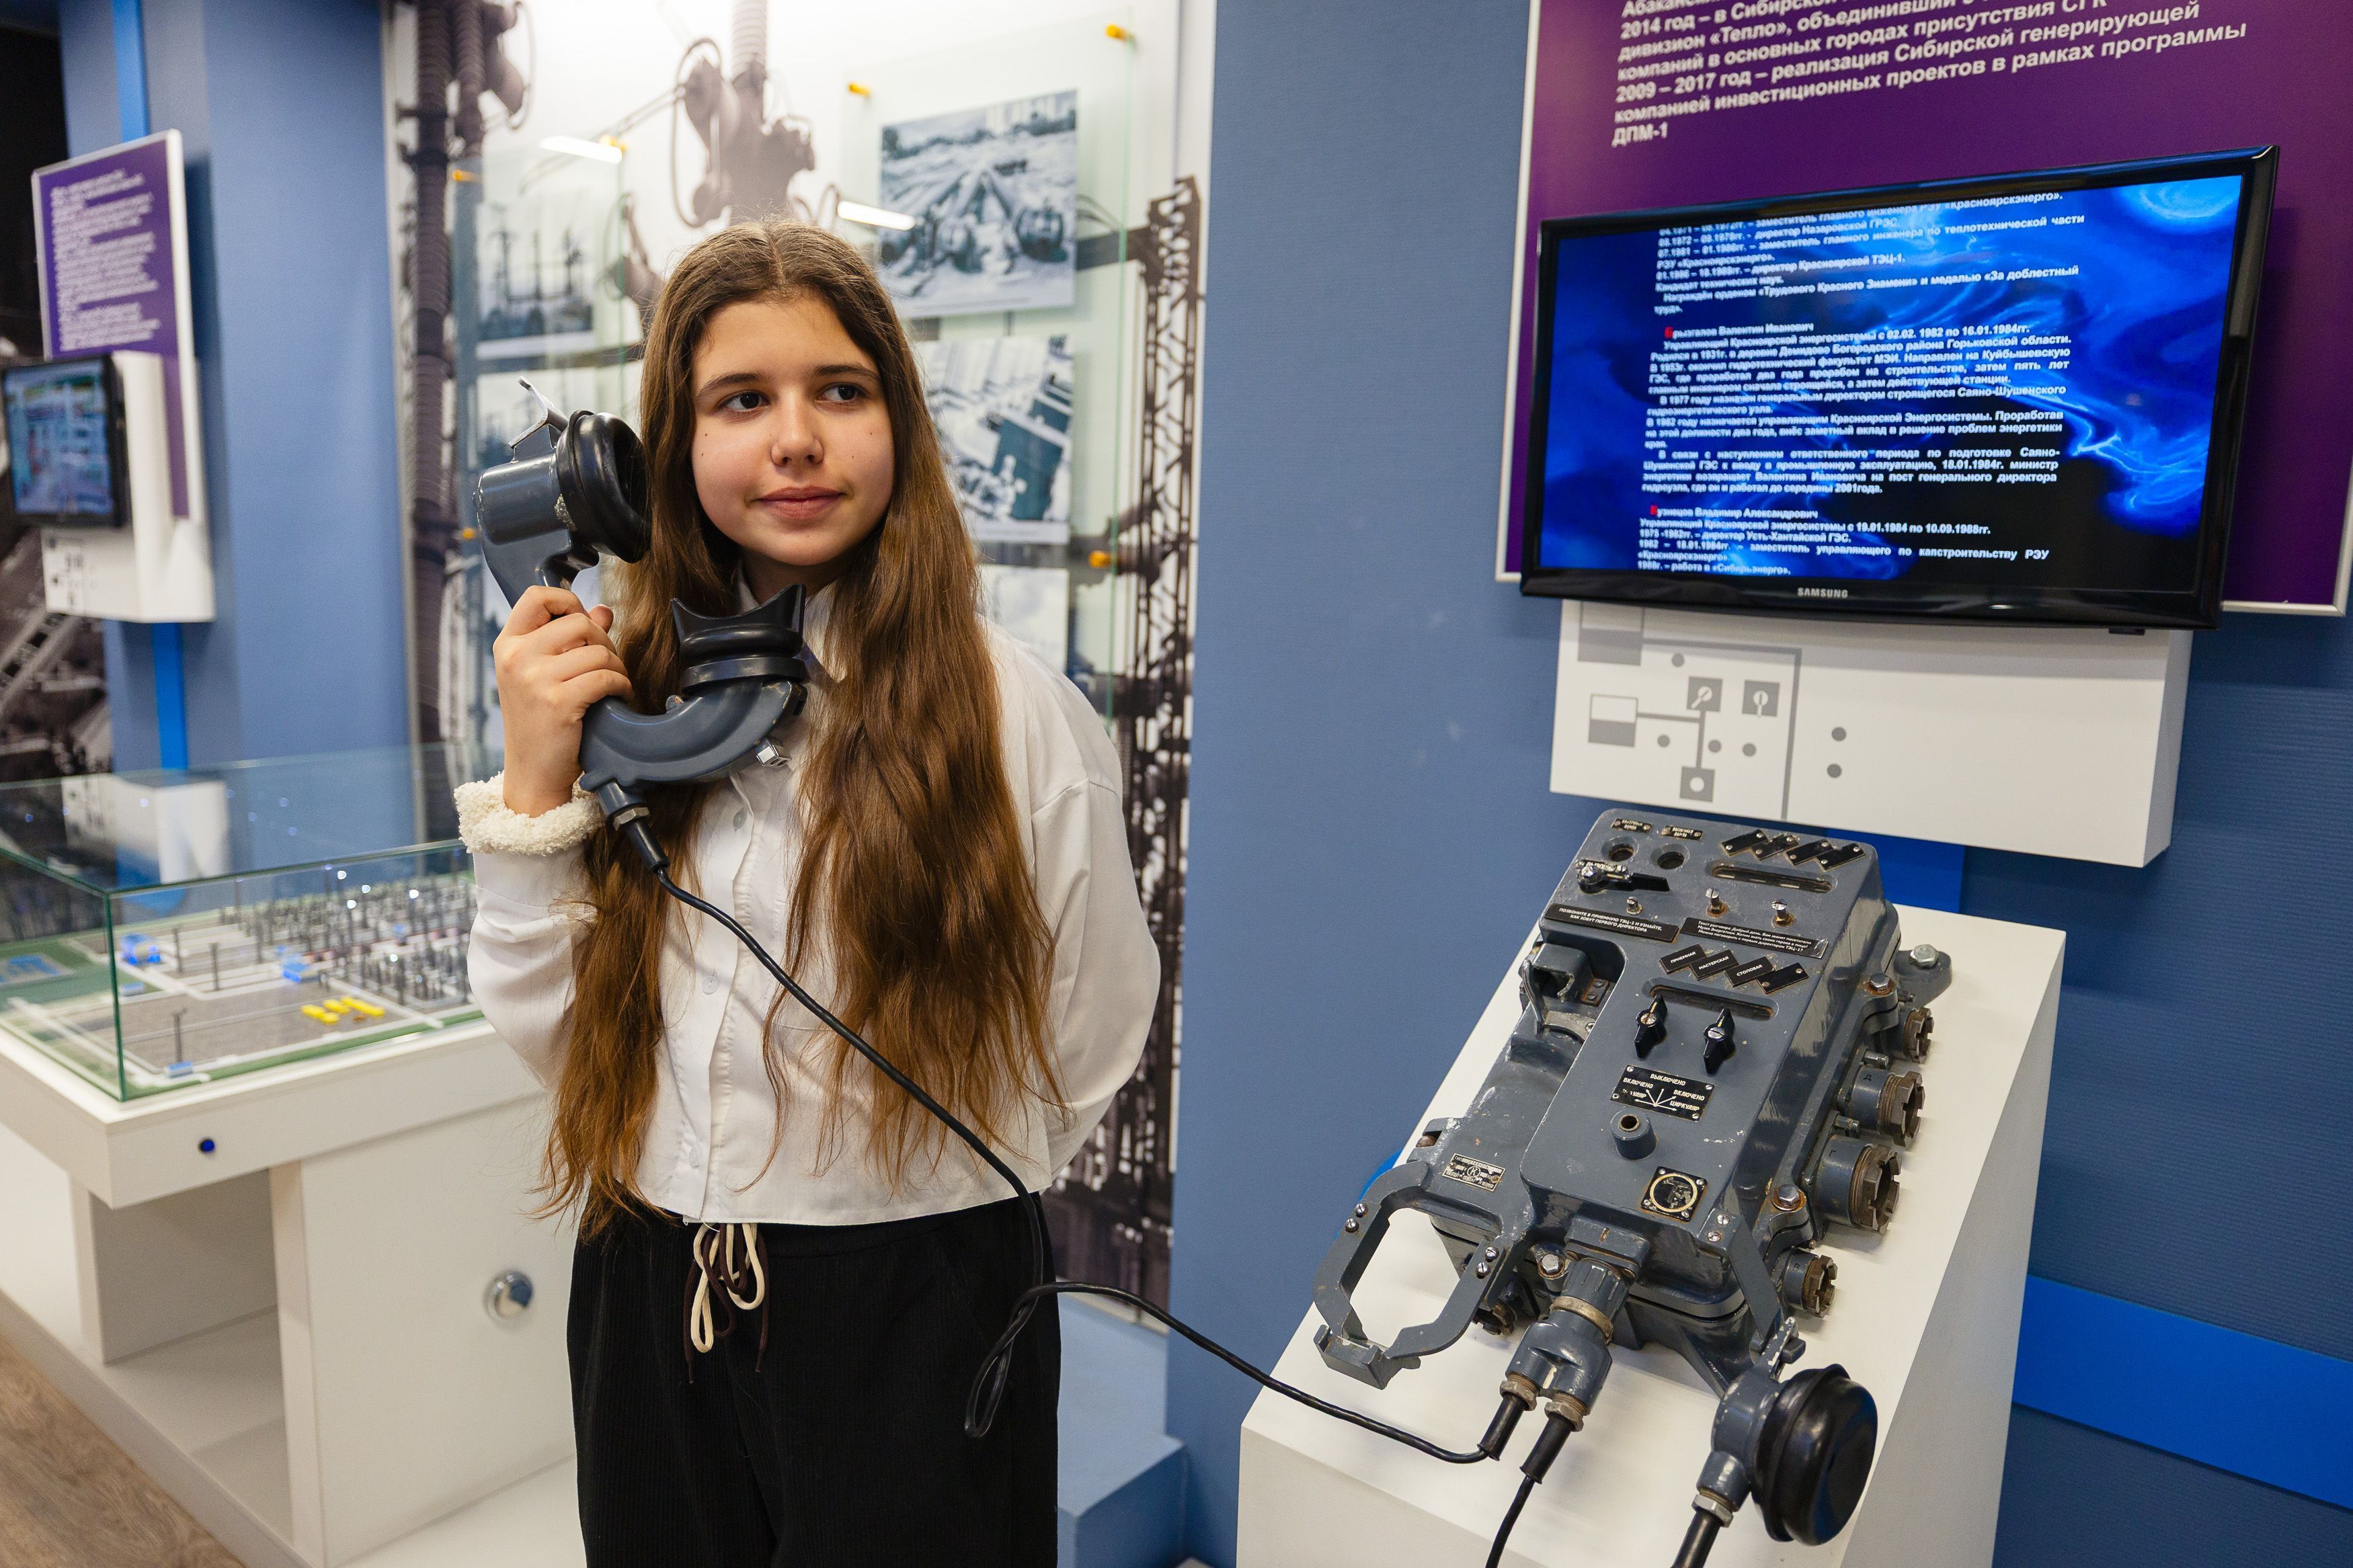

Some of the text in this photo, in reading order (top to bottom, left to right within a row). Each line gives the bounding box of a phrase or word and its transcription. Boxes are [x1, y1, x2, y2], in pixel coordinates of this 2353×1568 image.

[1621, 17, 1660, 39] 2014
[1664, 15, 1696, 30] год
[1714, 9, 1727, 23] в
[1616, 54, 1705, 80] компаний
[1708, 54, 1721, 67] в
[1723, 38, 1821, 64] основных
[1826, 24, 1909, 49] городах
[1914, 1, 2055, 37] присутствия
[1617, 35, 1706, 62] дивизион
[1710, 22, 1792, 43] «Тепло»,
[1615, 81, 1656, 102] 2009
[1674, 72, 1716, 93] 2017
[1719, 71, 1751, 86] год
[1771, 50, 1889, 82] реализация
[1895, 28, 2013, 60] Сибирской
[2020, 5, 2200, 42] генерирующей
[1614, 24, 2247, 122] компанией инвестиционных проектов в рамках программы
[1611, 122, 1668, 146] ДПМ-1
[1944, 216, 2046, 233] теплотехнической
[2051, 215, 2085, 224] части
[1930, 274, 1981, 284] медалью
[1984, 270, 2004, 280] «За
[2006, 265, 2079, 280] доблестный
[1945, 328, 1960, 336] по
[1906, 340, 1944, 352] района
[1947, 336, 2018, 349] Горьковской
[2021, 335, 2071, 345] области.
[1964, 352, 1979, 360] на
[1982, 348, 2071, 360] Куйбышевскую
[1974, 363, 2007, 372] затем
[2013, 362, 2041, 370] пять
[2048, 361, 2069, 369] лет
[1995, 410, 2063, 421] Проработав
[1948, 423, 1996, 435] проблем
[1999, 423, 2063, 434] энергетики
[1875, 450, 1919, 459] периода
[1948, 449, 2012, 458] подготовке
[2020, 447, 2060, 456] Саяно-
[2009, 461, 2059, 470] министр
[1870, 473, 1884, 481] на
[1888, 473, 1914, 481] пост
[1918, 473, 1992, 483] генерального
[1996, 473, 2057, 483] директора
[1909, 524, 1923, 532] по
[1898, 547, 1912, 556] по
[2024, 549, 2049, 559] РЭУ
[1798, 587, 1848, 597] SAMSUNG
[1670, 951, 1696, 964] ПРИЕМНАЯ
[1699, 956, 1729, 970] МАСТЕРСКАЯ
[1737, 964, 1763, 977] СТОЛОВАЯ
[1623, 1077, 1654, 1089] ВКЛЮЧЕНО
[1650, 1073, 1686, 1086] ВЫКЛЮЧЕНО
[1673, 1089, 1705, 1101] ВКЛЮЧЕНО
[1669, 1100, 1700, 1112] ЦИРКУЛЯР
